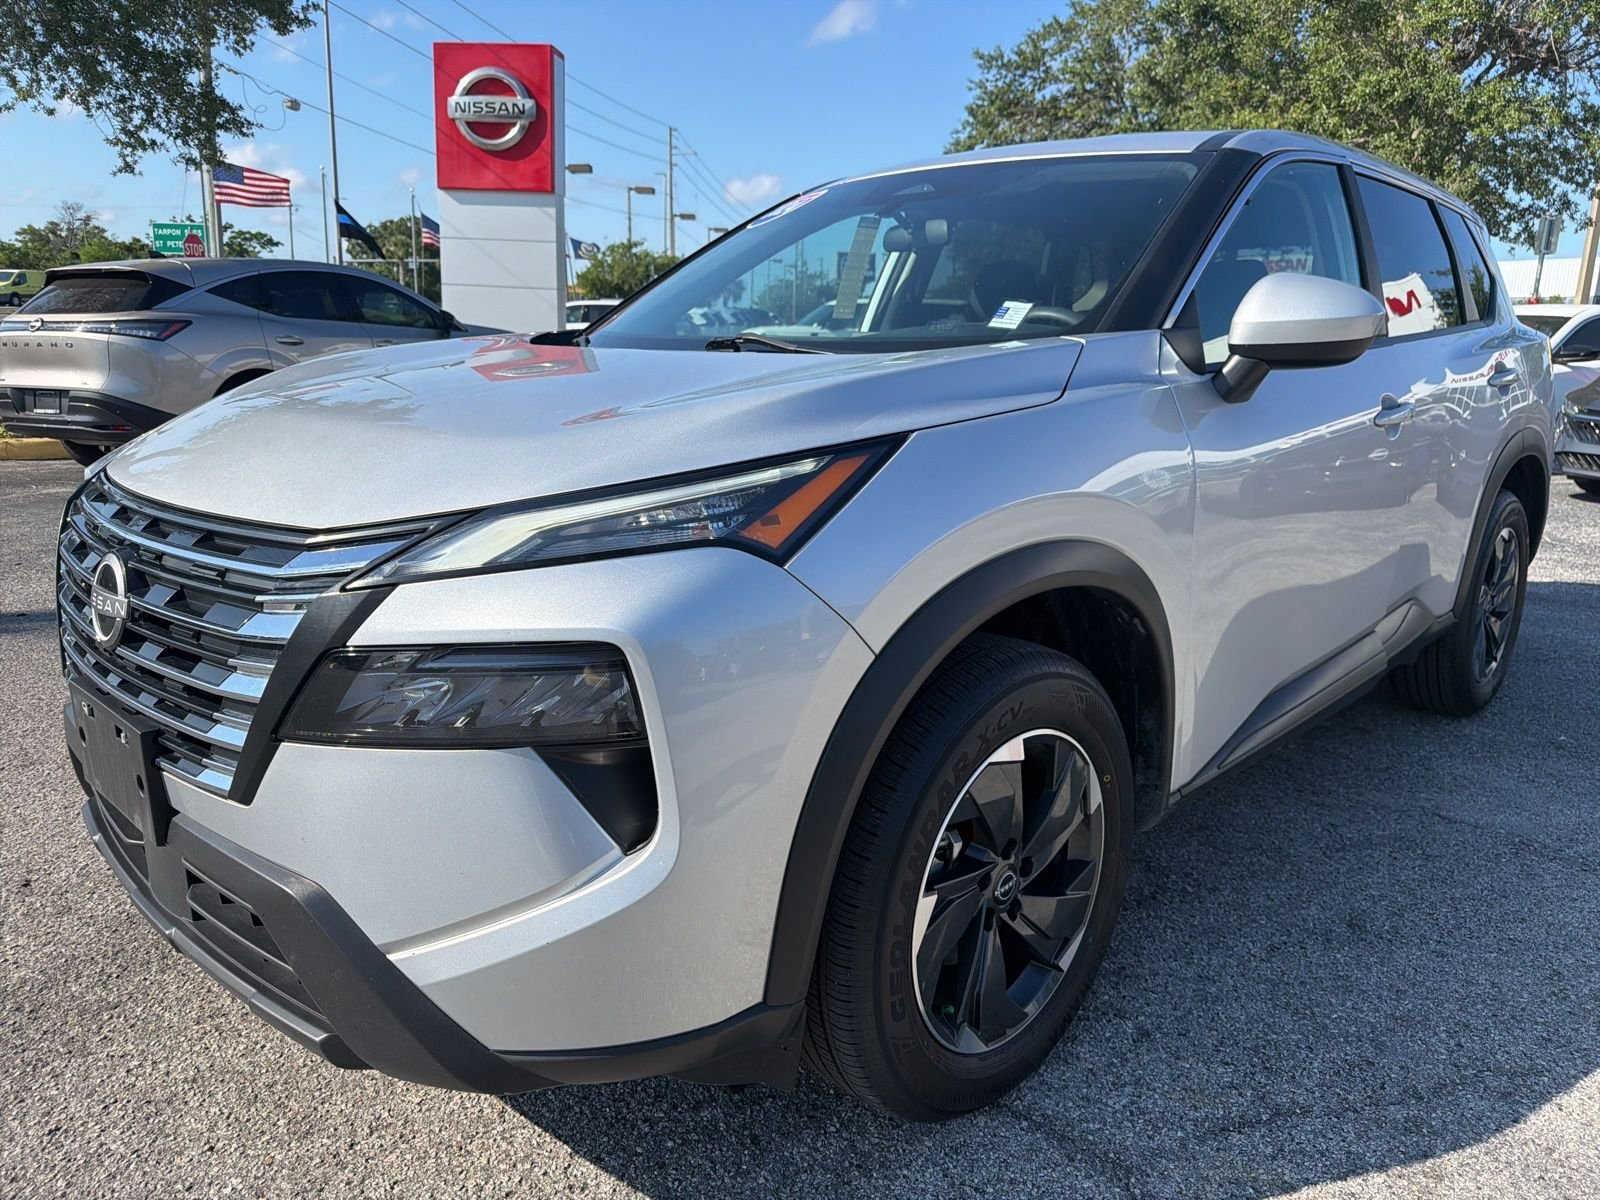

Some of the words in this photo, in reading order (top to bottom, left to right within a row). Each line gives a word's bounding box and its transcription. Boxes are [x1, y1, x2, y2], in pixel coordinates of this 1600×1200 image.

[454, 101, 525, 115] NISSAN
[154, 228, 181, 236] TARPON
[155, 240, 163, 248] ST
[184, 242, 204, 257] STOP
